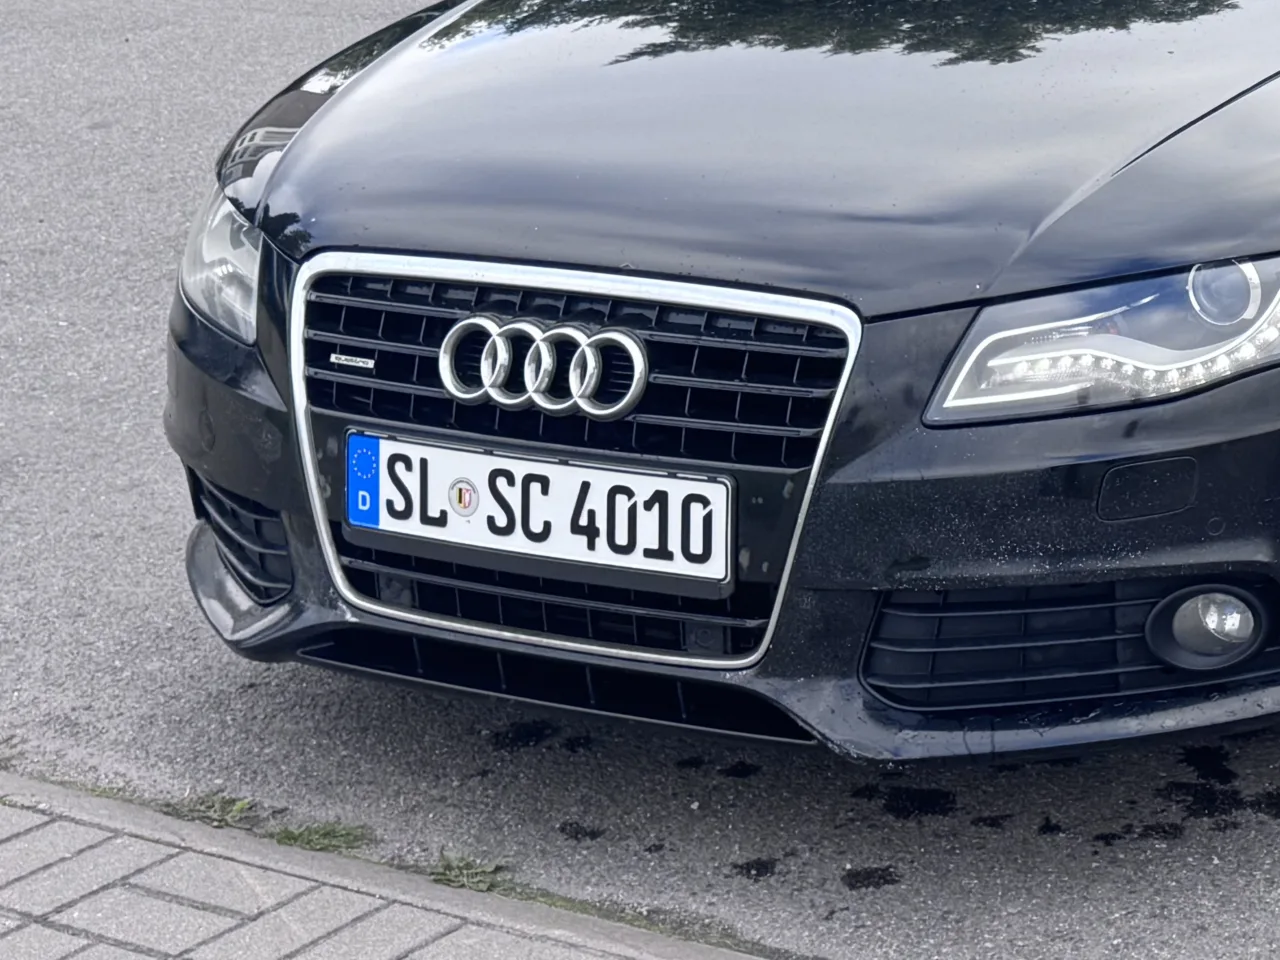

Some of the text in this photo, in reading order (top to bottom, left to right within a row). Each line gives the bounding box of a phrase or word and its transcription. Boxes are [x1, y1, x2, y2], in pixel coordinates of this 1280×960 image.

[358, 490, 371, 511] D
[385, 452, 713, 564] SL SC 4010
